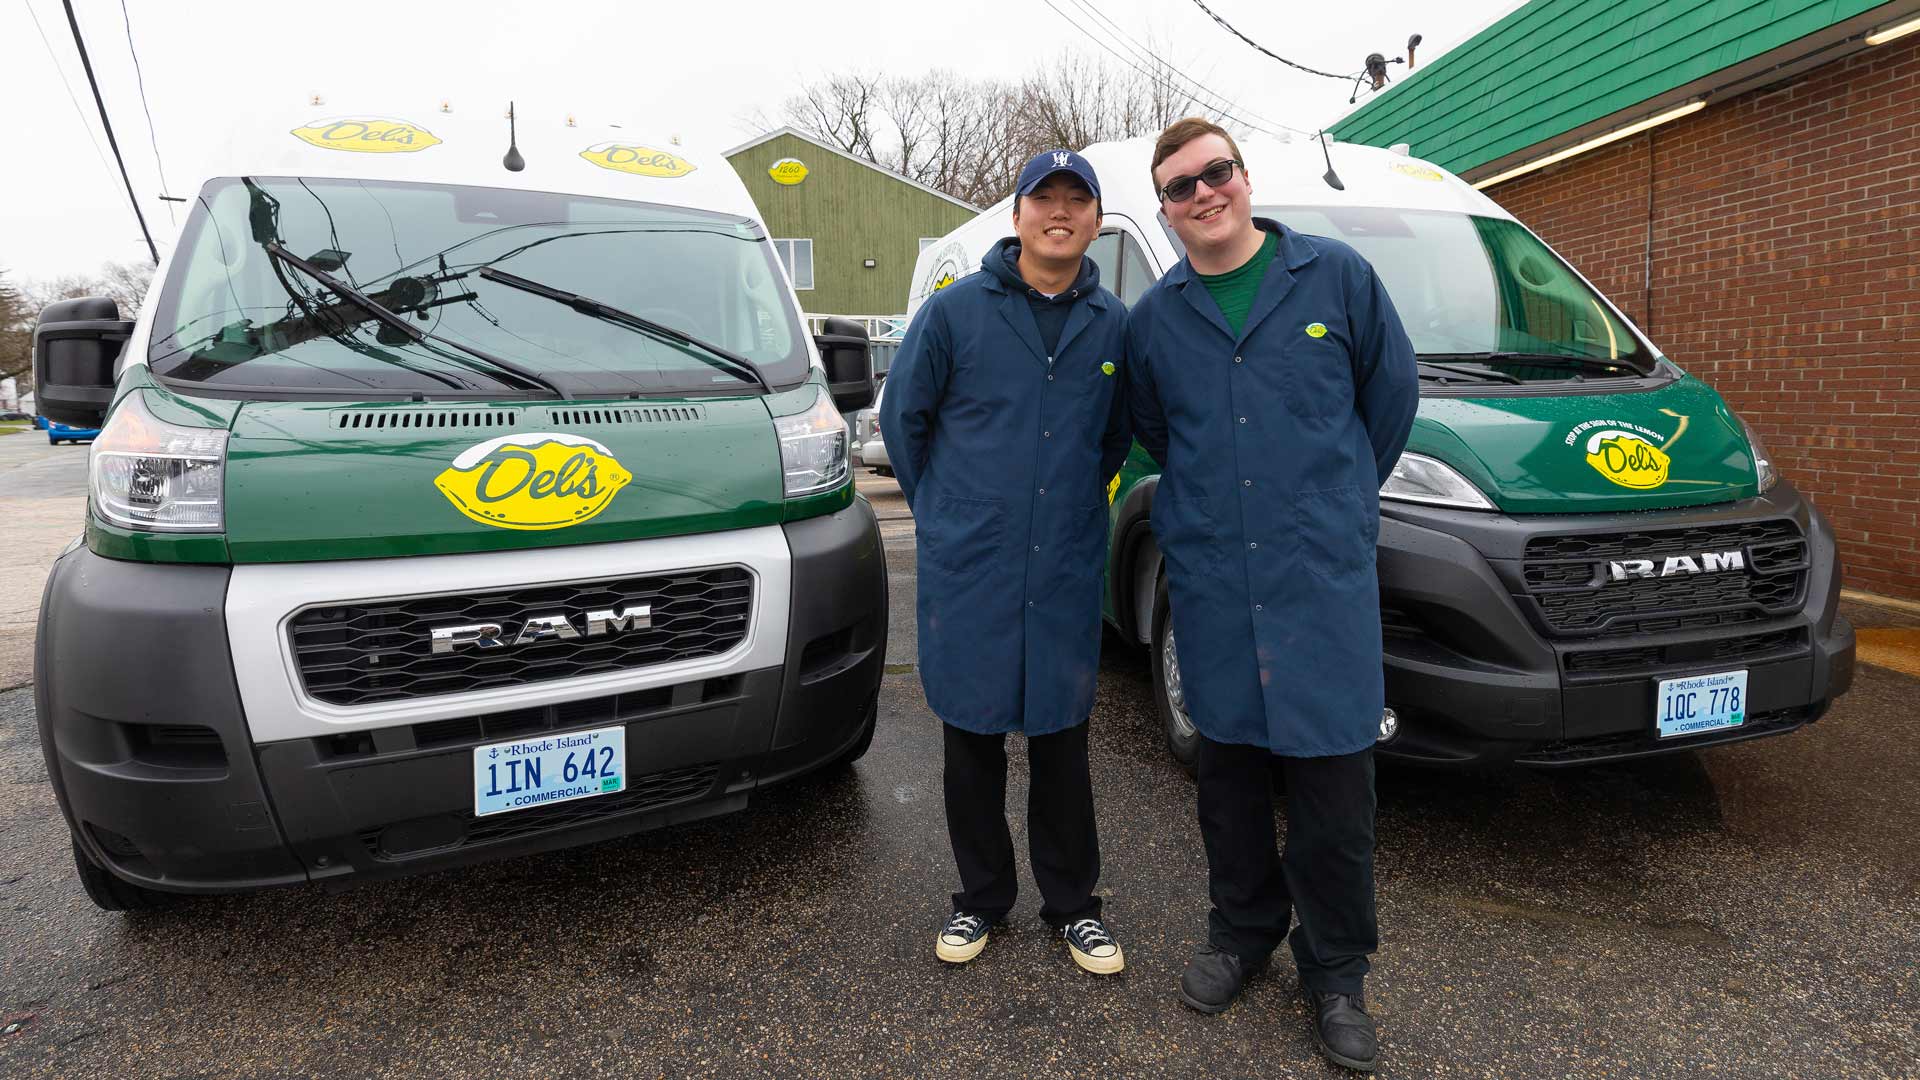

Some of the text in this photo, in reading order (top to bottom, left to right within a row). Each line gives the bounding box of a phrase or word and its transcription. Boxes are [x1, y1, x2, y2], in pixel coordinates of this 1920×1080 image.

[1564, 419, 1664, 446] STOP AT THE SIGN OF THE LEMON
[1601, 442, 1661, 473] Del's
[476, 450, 606, 503] Del's
[1609, 550, 1745, 581] RAM
[431, 605, 651, 654] RAM
[1680, 675, 1728, 691] Rhode Island
[1664, 686, 1740, 722] 1QC 778
[1680, 718, 1725, 731] COMMERCIAL
[511, 733, 592, 756] Rhode Island
[486, 746, 615, 797] 1IN 642
[603, 778, 617, 786] MAR
[514, 785, 591, 806] COMMERCIAL
